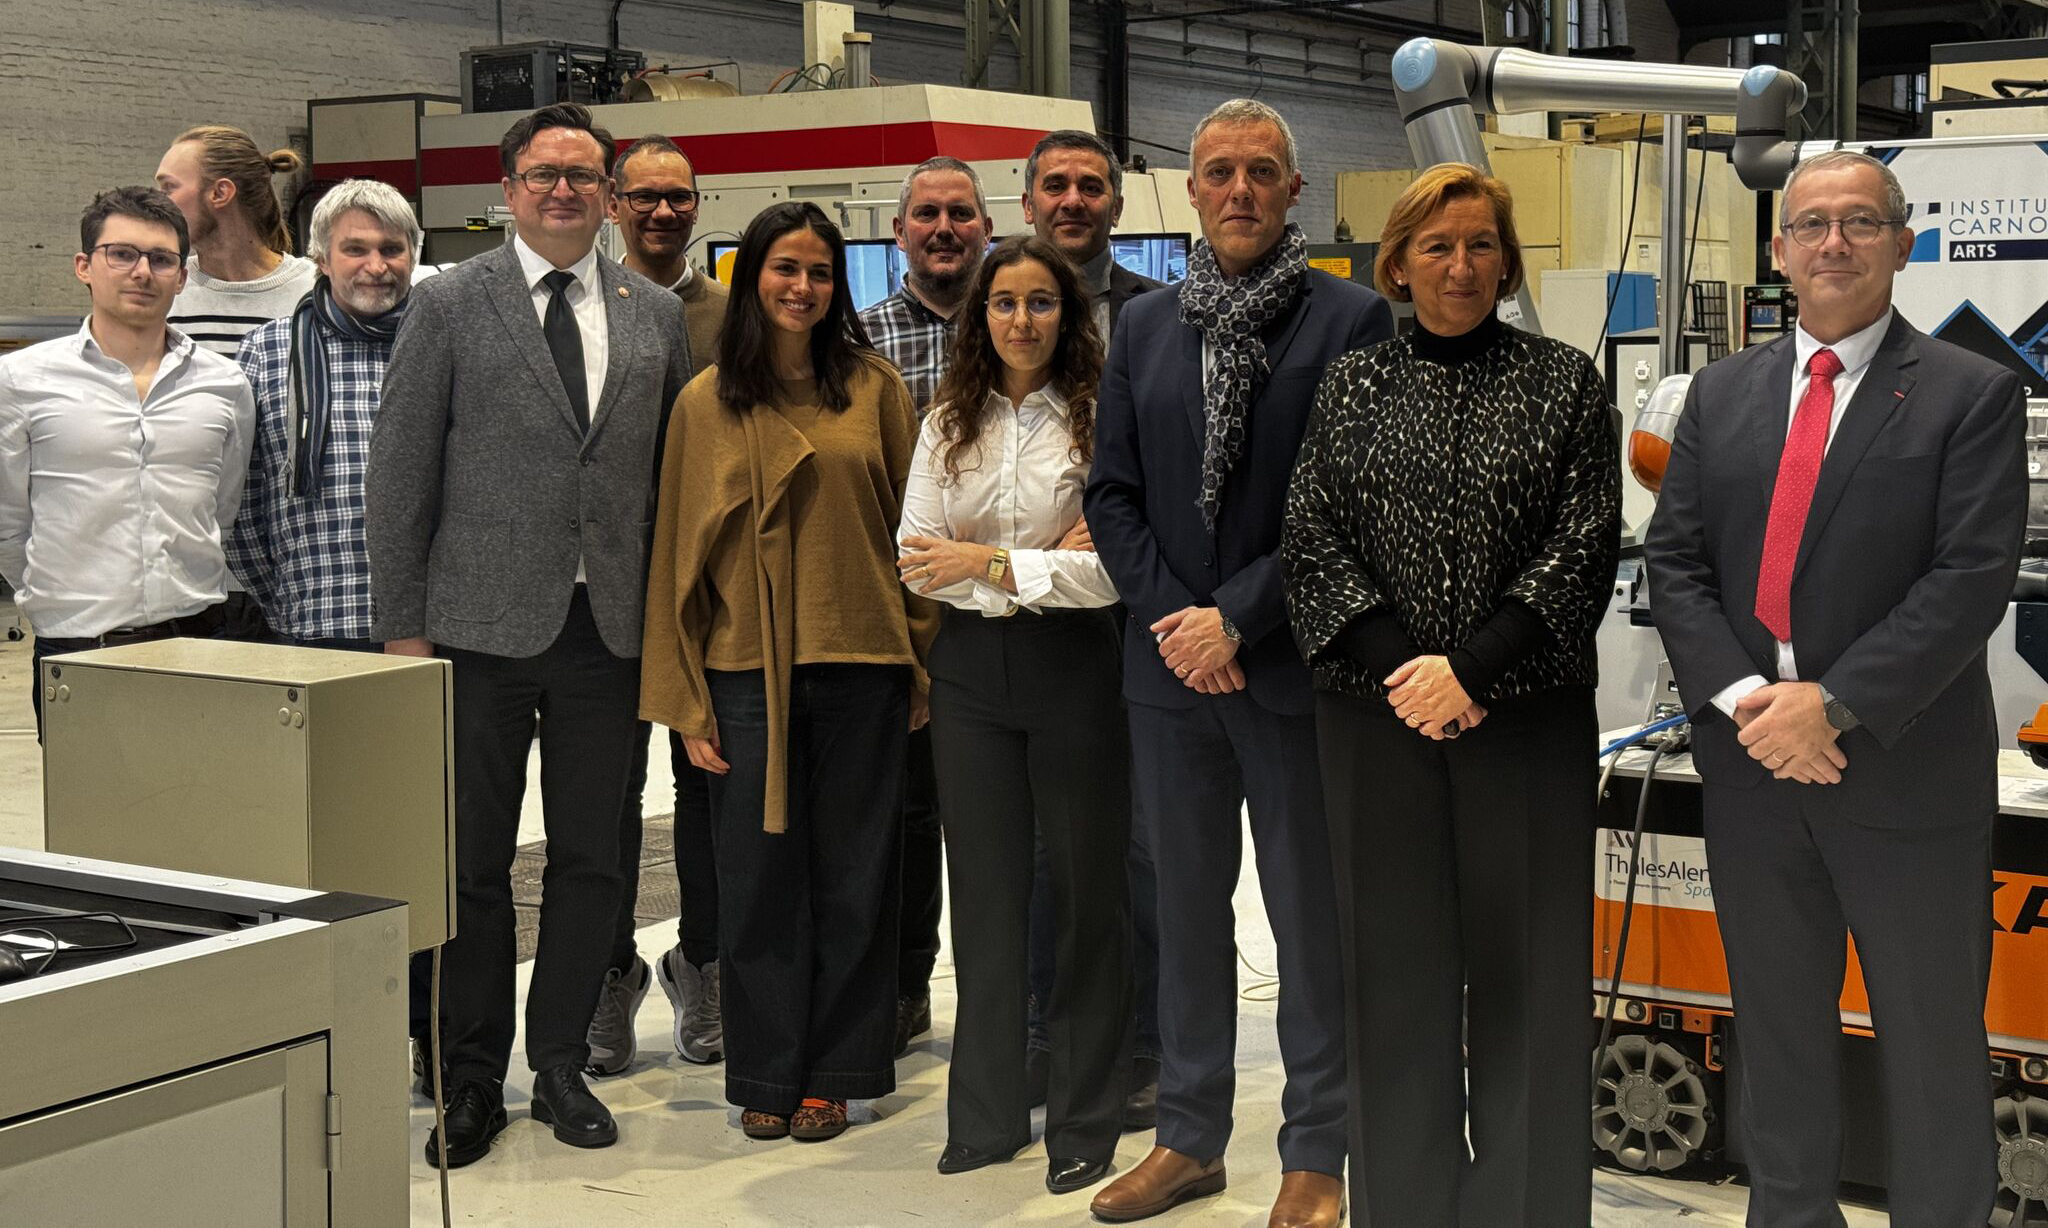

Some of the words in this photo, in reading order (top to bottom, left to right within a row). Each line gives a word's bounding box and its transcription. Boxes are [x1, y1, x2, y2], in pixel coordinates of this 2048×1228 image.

[1949, 216, 2047, 235] CARNO
[1953, 243, 1997, 258] ARTS
[1604, 852, 1710, 882] ThlesAlen
